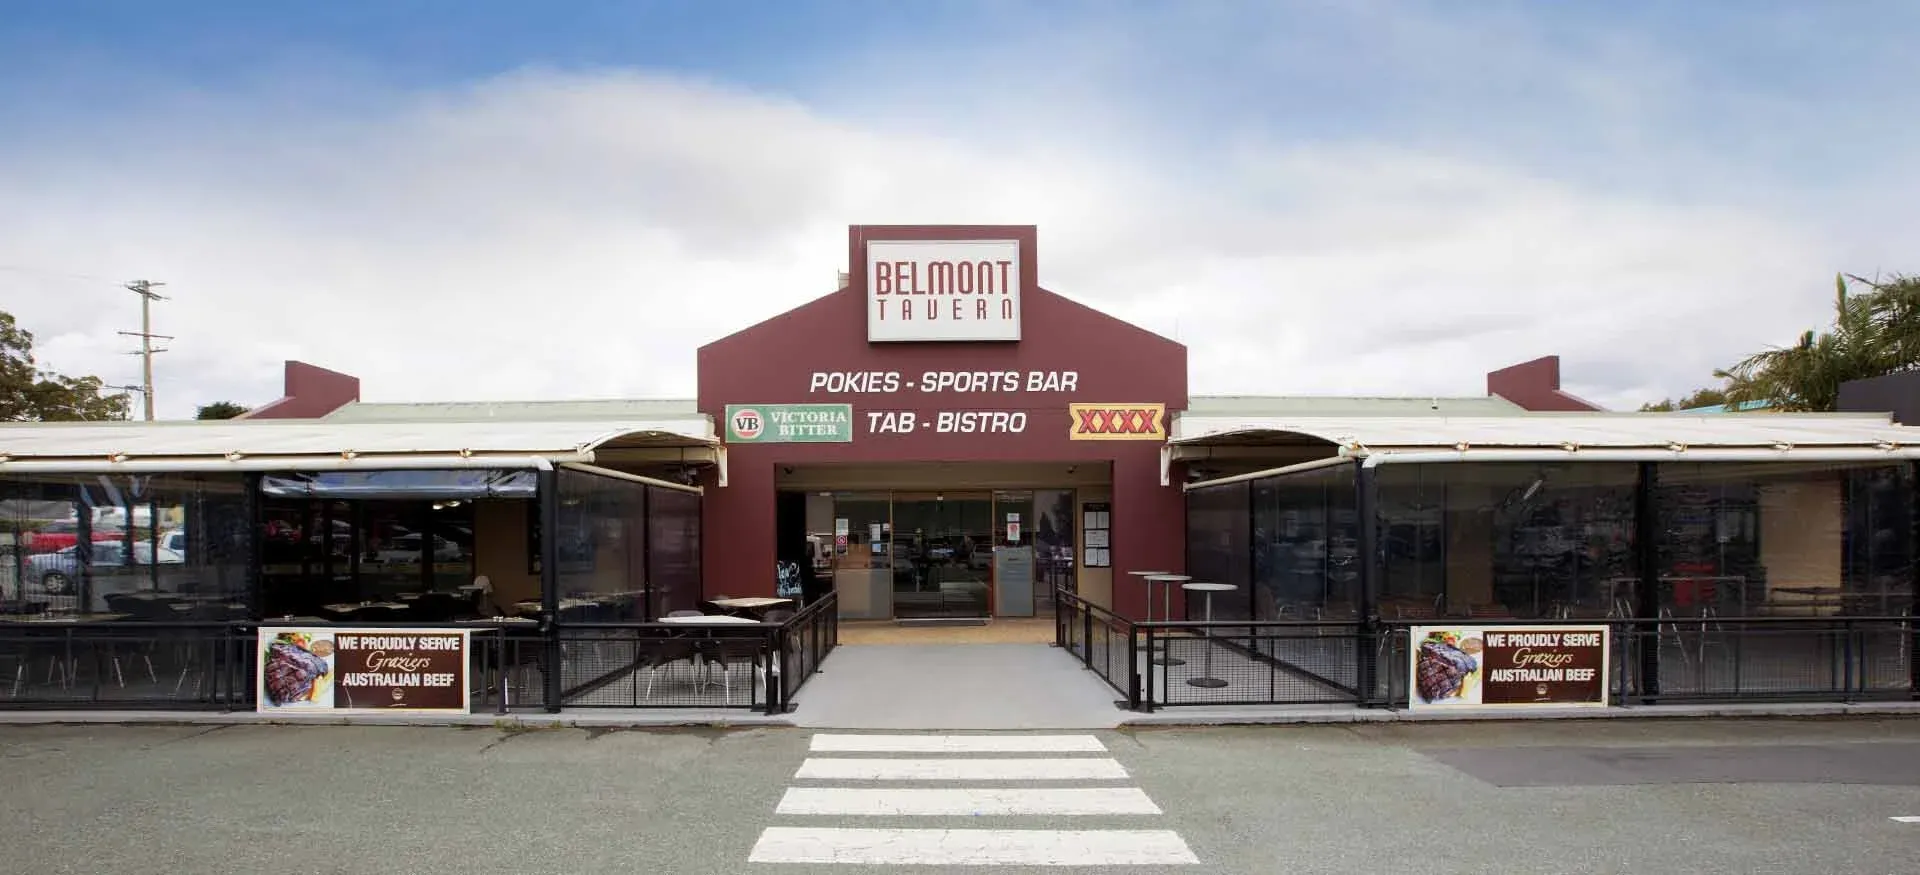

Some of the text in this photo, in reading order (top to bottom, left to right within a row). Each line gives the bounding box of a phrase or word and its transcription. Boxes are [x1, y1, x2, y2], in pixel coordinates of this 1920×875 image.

[875, 261, 1012, 295] BELMONT
[876, 298, 1013, 320] TAVERN
[810, 372, 900, 393] POKIES
[920, 372, 1019, 392] SPORTS
[1026, 372, 1078, 392] BAR
[735, 417, 759, 430] VB
[771, 411, 847, 423] VICTORIA
[867, 412, 917, 433] TAB
[936, 412, 1027, 433] BISTRO
[1076, 409, 1157, 434] XXXX
[779, 424, 837, 436] BITTER
[338, 636, 460, 650] WE PROUDLY SERVE
[1486, 633, 1600, 647] WE PROUDLY SERVE
[366, 650, 431, 673] Graziers
[1512, 647, 1574, 668] Graziers
[342, 672, 455, 687] AUSTRALIAN BEEF
[1490, 668, 1595, 682] AUSTRALIAN BEEF
